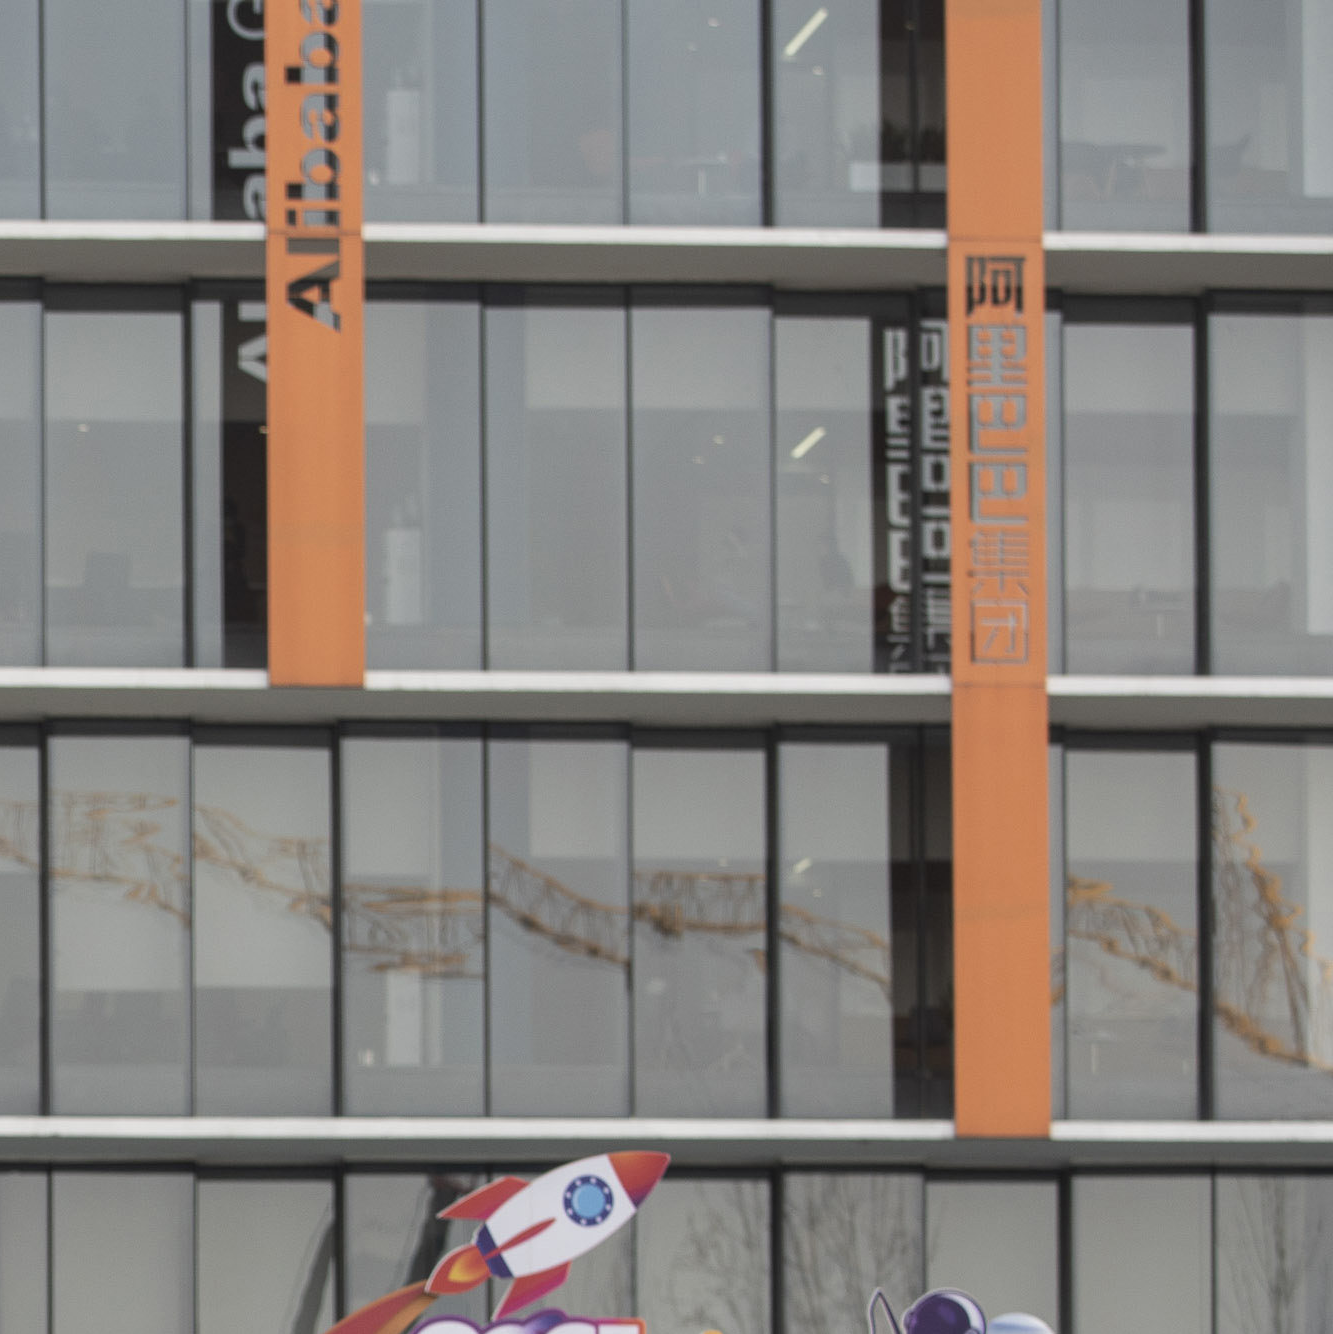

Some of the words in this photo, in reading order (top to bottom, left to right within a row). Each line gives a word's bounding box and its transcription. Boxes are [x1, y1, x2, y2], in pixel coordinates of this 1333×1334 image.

[966, 256, 1030, 665] 阿里巴巴集团
